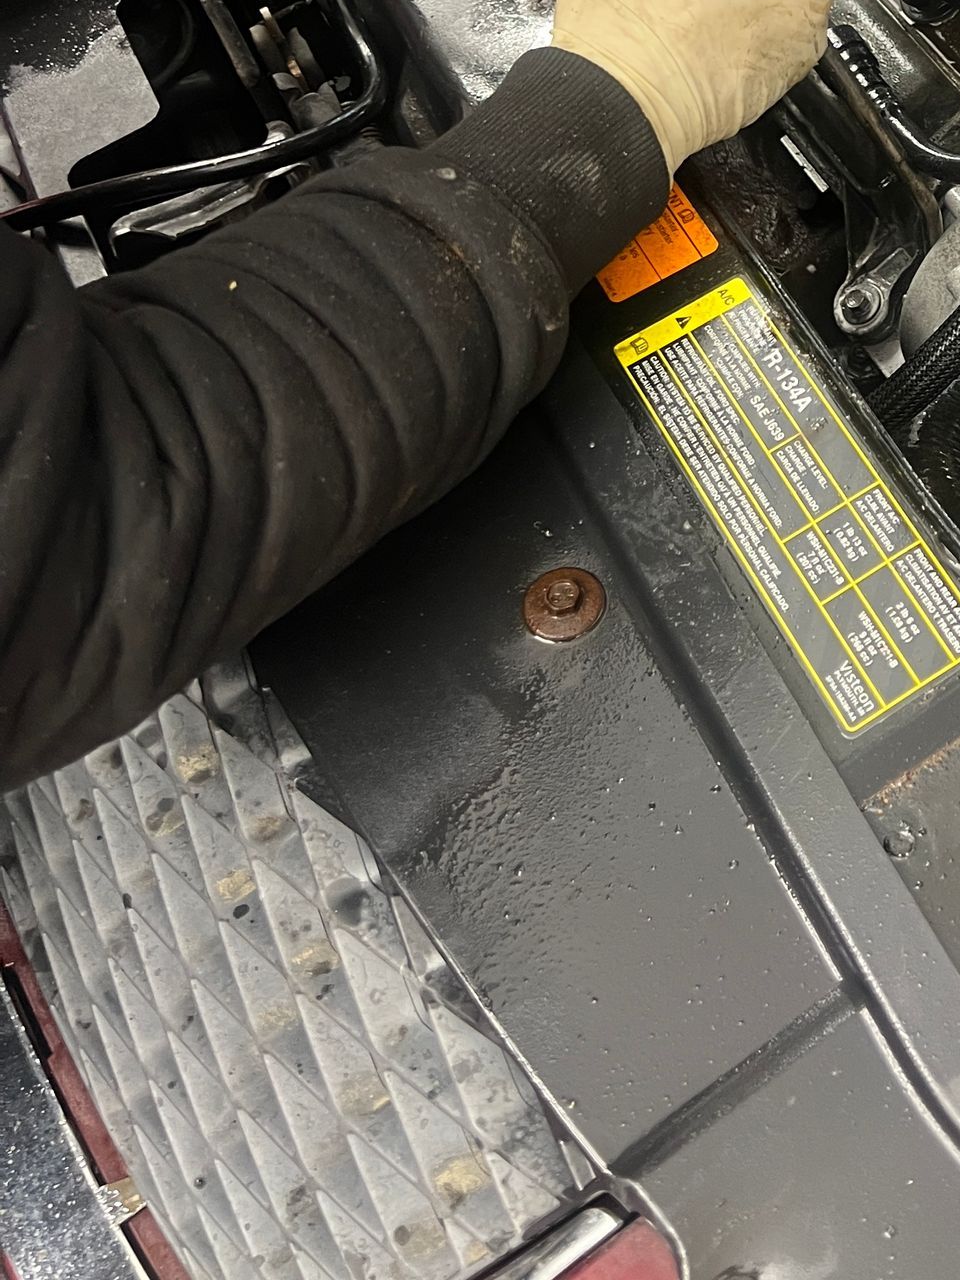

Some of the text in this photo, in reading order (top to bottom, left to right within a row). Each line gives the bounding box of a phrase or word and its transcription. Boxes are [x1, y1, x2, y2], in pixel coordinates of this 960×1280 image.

[717, 286, 736, 306] A/C
[680, 336, 711, 377] REFRIGERANT
[726, 359, 738, 370] LA
[649, 373, 661, 385] EN
[760, 348, 815, 414] R-134A
[654, 382, 673, 405] GARDE
[665, 381, 686, 407] SYSTEM
[669, 406, 681, 418] NE
[680, 405, 692, 416] TO
[686, 413, 697, 425] BE
[719, 414, 730, 426] LA
[748, 393, 786, 443] SAE J639
[663, 346, 677, 360] USE
[671, 358, 690, 381] ACEITE
[684, 378, 700, 397] PARA
[725, 442, 752, 479] CONFORME
[750, 482, 771, 508] NORMA
[691, 422, 716, 455] SERVICED
[724, 423, 745, 448] NORME
[710, 452, 722, 465] BY
[738, 445, 756, 466] FORD
[774, 449, 796, 475] CARGA
[789, 471, 801, 484] DE
[783, 444, 806, 473] CHARGE
[792, 439, 829, 490] CHARGE LEVEL:
[656, 403, 668, 415] EL
[677, 437, 694, 458] DEBE
[688, 454, 703, 471] SER
[696, 468, 722, 502] ATENDIDO
[715, 499, 733, 521] SOLO
[727, 517, 742, 535] POR
[736, 532, 764, 571] PERSONAL
[716, 461, 743, 497] QUALIFIED
[726, 495, 738, 509] UN
[871, 487, 892, 513] FRONT
[732, 505, 762, 547] PERSONNEL
[854, 498, 895, 553] A/C DELANTERO
[875, 511, 895, 535] AVANT
[850, 535, 863, 547] 13
[856, 544, 868, 557] oz
[895, 558, 909, 573] A/C
[903, 570, 937, 614] DELANTERO
[903, 552, 943, 606] CLIMATISATION
[937, 602, 950, 616] AV
[944, 613, 957, 626] ET
[912, 547, 934, 573] FRONT
[928, 570, 944, 589] AND
[938, 586, 958, 609] REAR
[908, 623, 920, 636] oz
[836, 658, 877, 713] Visteon
